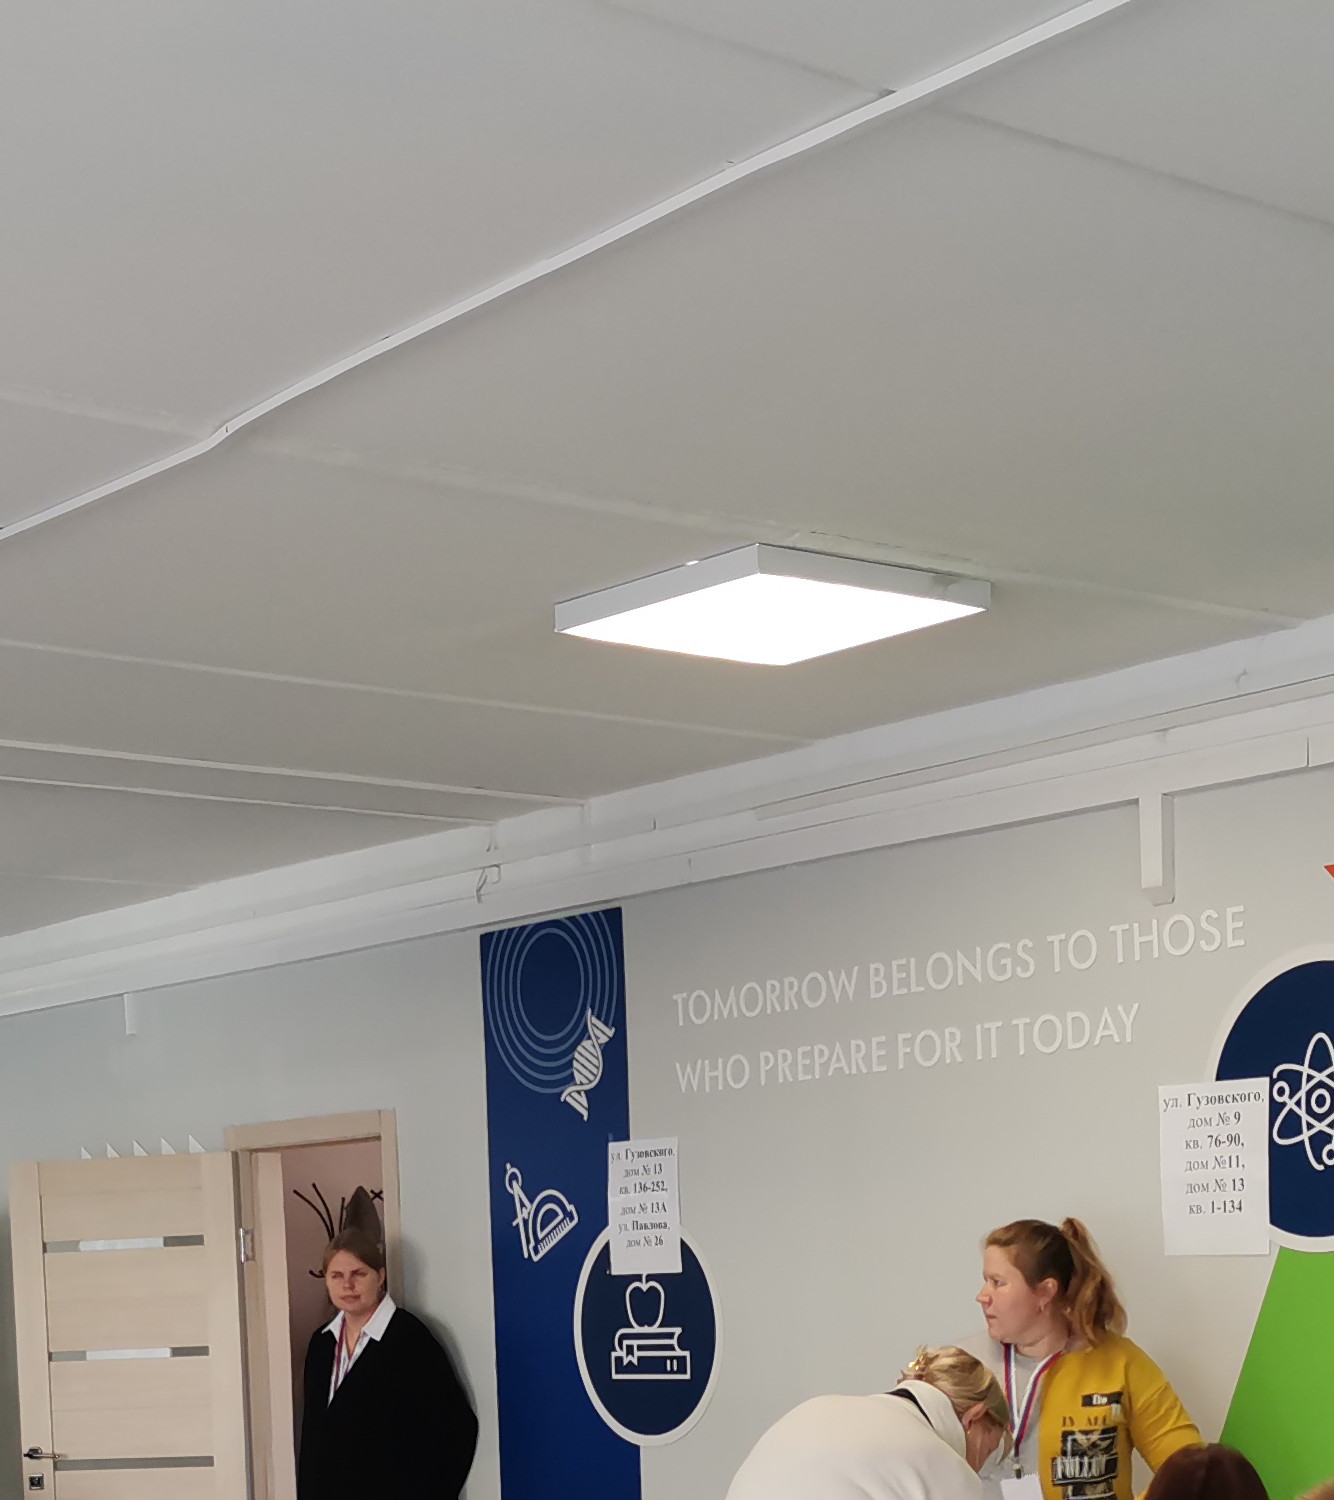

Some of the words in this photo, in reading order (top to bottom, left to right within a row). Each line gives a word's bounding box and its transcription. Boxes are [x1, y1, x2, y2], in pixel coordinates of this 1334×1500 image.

[673, 966, 859, 1027] TOMORROW
[869, 937, 1036, 999] BELONGS
[1046, 929, 1098, 973] TO
[1109, 905, 1246, 964] THOSE
[675, 1053, 751, 1093] WHO
[760, 1035, 887, 1086] PREPARE
[897, 1026, 963, 1070] FOR
[975, 1021, 1003, 1061] IT
[1012, 1003, 1139, 1056] TODAY
[1163, 1097, 1183, 1113] ул.
[1187, 1091, 1266, 1111] Гузовского,
[1187, 1116, 1213, 1130] дом
[1216, 1112, 1231, 1127] №
[1233, 1111, 1242, 1126] 9
[1185, 1138, 1203, 1150] кв.
[1206, 1132, 1245, 1149] 76-90,
[653, 1162, 663, 1175] 13
[1184, 1159, 1209, 1173] дом
[1185, 1181, 1210, 1195] дом
[1212, 1178, 1228, 1194] №
[1231, 1177, 1245, 1192] 13
[1188, 1203, 1206, 1215] кв.
[1210, 1199, 1243, 1215] 1-134
[654, 1235, 664, 1247] 26
